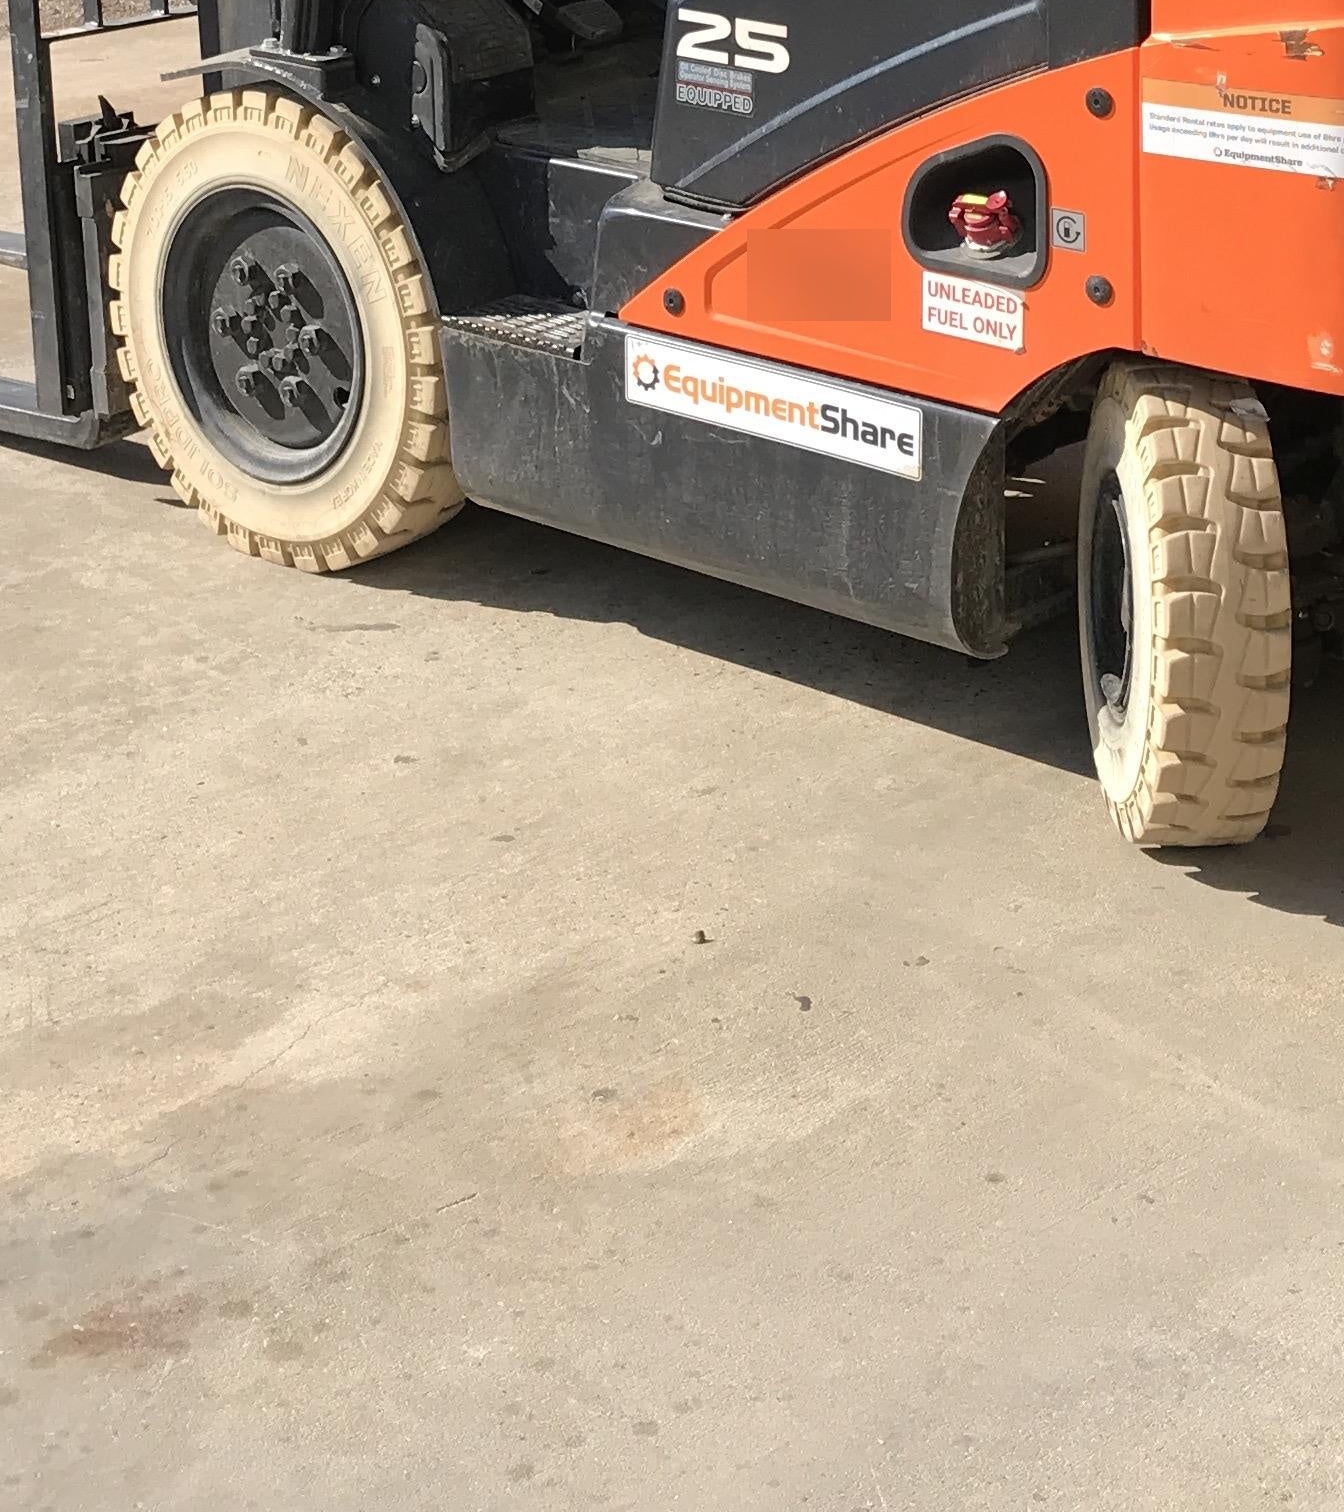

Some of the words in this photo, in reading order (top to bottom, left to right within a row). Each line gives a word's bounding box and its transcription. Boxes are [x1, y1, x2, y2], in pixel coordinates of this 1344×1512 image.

[676, 7, 790, 75] 25
[676, 83, 754, 114] EQUIPPED
[1223, 93, 1292, 115] NOTICE
[1149, 112, 1181, 122] Standard
[1183, 116, 1205, 126] Rental
[1206, 120, 1226, 129] rates
[1227, 123, 1247, 133] apply
[1257, 127, 1297, 139] equipment
[1298, 131, 1312, 140] use
[1149, 123, 1171, 134] Usage
[1172, 127, 1208, 139] exceeding
[1240, 135, 1253, 145] day
[1268, 138, 1290, 148] result
[1301, 142, 1339, 155] additional
[1223, 148, 1304, 167] EquipmentShare
[927, 280, 1019, 315] UNLEADED
[927, 305, 969, 331] FUEL
[972, 316, 1018, 342] ONLY
[662, 363, 915, 458] EquipmentShare
